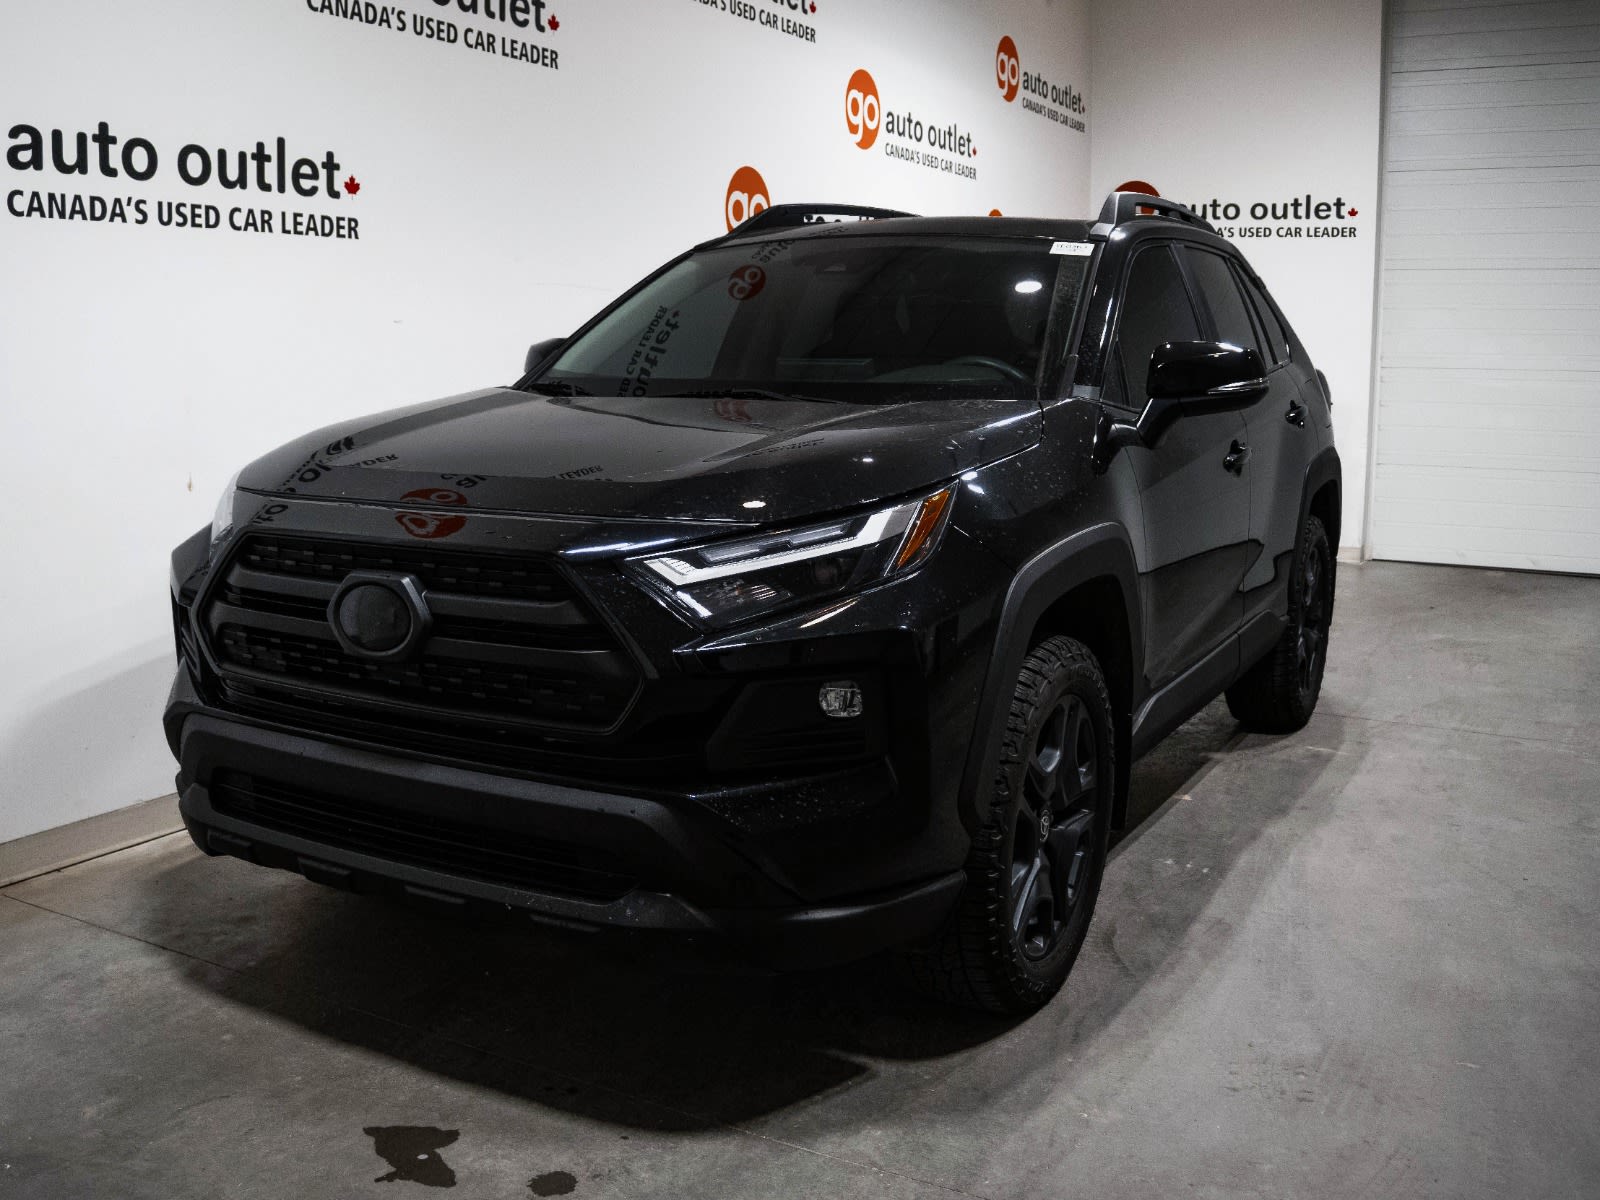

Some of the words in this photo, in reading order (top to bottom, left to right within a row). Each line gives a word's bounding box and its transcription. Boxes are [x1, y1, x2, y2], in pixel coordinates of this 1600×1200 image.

[412, 14, 459, 44] USED
[463, 27, 497, 55] CAR
[501, 37, 559, 70] LEADER
[729, 0, 757, 22] USED
[759, 9, 779, 30] CAR
[781, 17, 816, 43] LEADER
[998, 52, 1018, 97] go
[1022, 71, 1049, 99] auto
[1051, 84, 1083, 115] outlet
[847, 89, 879, 146] go
[885, 111, 923, 143] auto
[928, 123, 972, 158] outlet
[1022, 97, 1046, 117] CANADA'S
[1047, 107, 1060, 122] USED
[1060, 113, 1069, 126] CAR
[1069, 118, 1086, 133] LEADER
[6, 121, 159, 182] auto
[177, 136, 341, 200] outlet
[885, 142, 921, 165] CANADA'S
[922, 152, 939, 169] USED
[941, 158, 953, 174] CAR
[954, 162, 977, 180] LEADER
[6, 189, 149, 225] CANADA'S
[157, 200, 221, 229] USED
[228, 206, 274, 234] CAR
[281, 211, 360, 240] LEADER
[1180, 198, 1241, 221] uto
[1249, 194, 1346, 221] outlet
[1238, 226, 1272, 238] USED
[1276, 226, 1302, 238] CAR
[1306, 226, 1357, 238] LEADER
